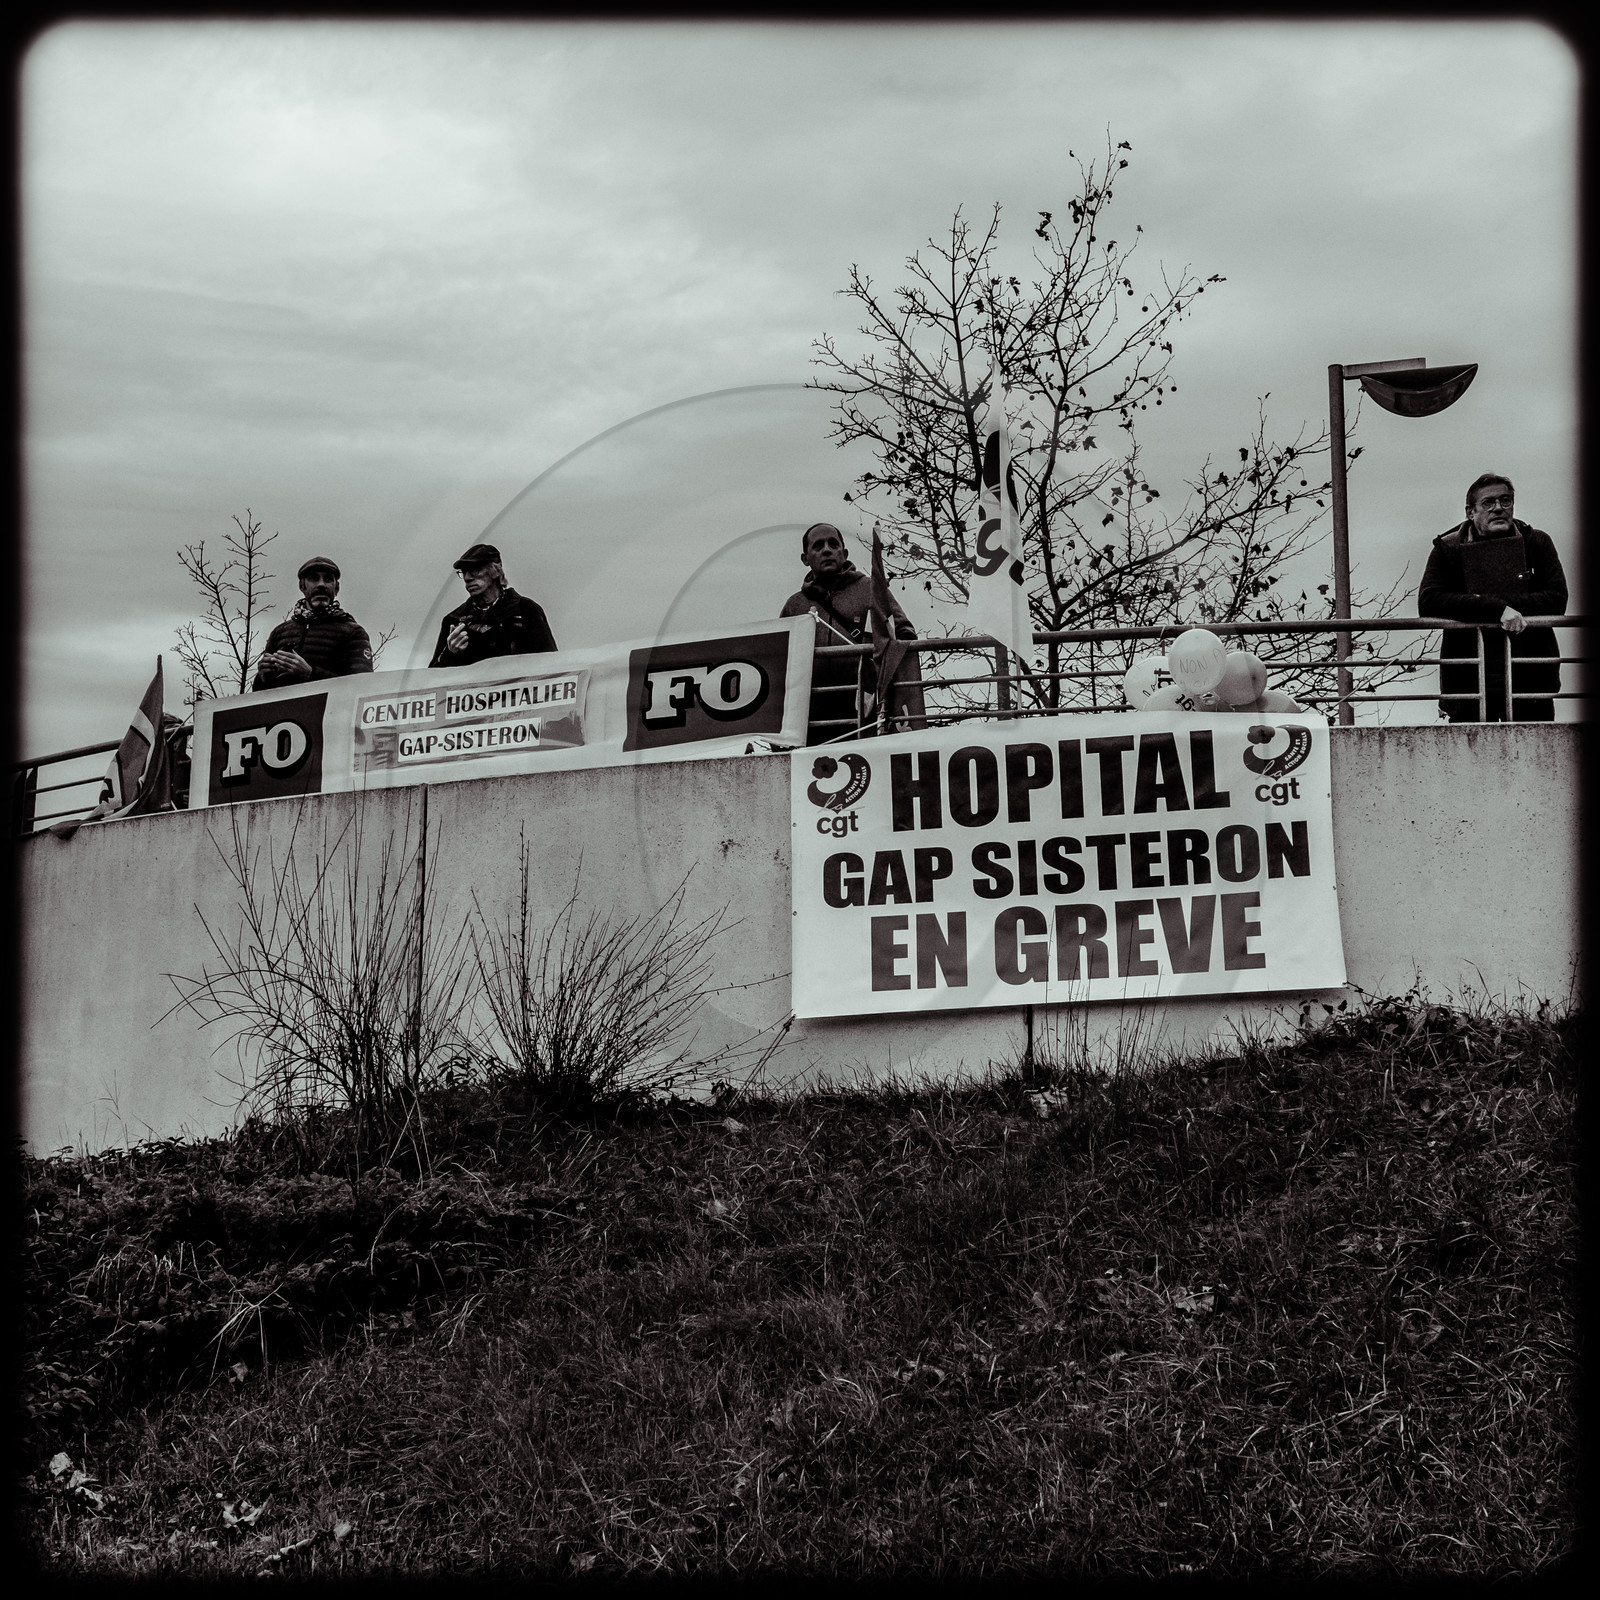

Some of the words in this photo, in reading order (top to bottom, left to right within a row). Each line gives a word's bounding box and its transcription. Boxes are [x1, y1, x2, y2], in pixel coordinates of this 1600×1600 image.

[362, 698, 436, 724] CENTRE
[446, 681, 577, 715] HOSPITALIER
[646, 662, 762, 720] FO
[222, 721, 307, 778] FO
[399, 722, 541, 757] GAP-SISTERON
[890, 729, 1231, 832] HOPITAL
[1255, 777, 1301, 806] cgt
[816, 810, 859, 839] cgt
[823, 846, 954, 908] GAP
[971, 820, 1311, 899] SISTERON
[870, 911, 969, 992] EN
[994, 892, 1267, 986] GREVE
